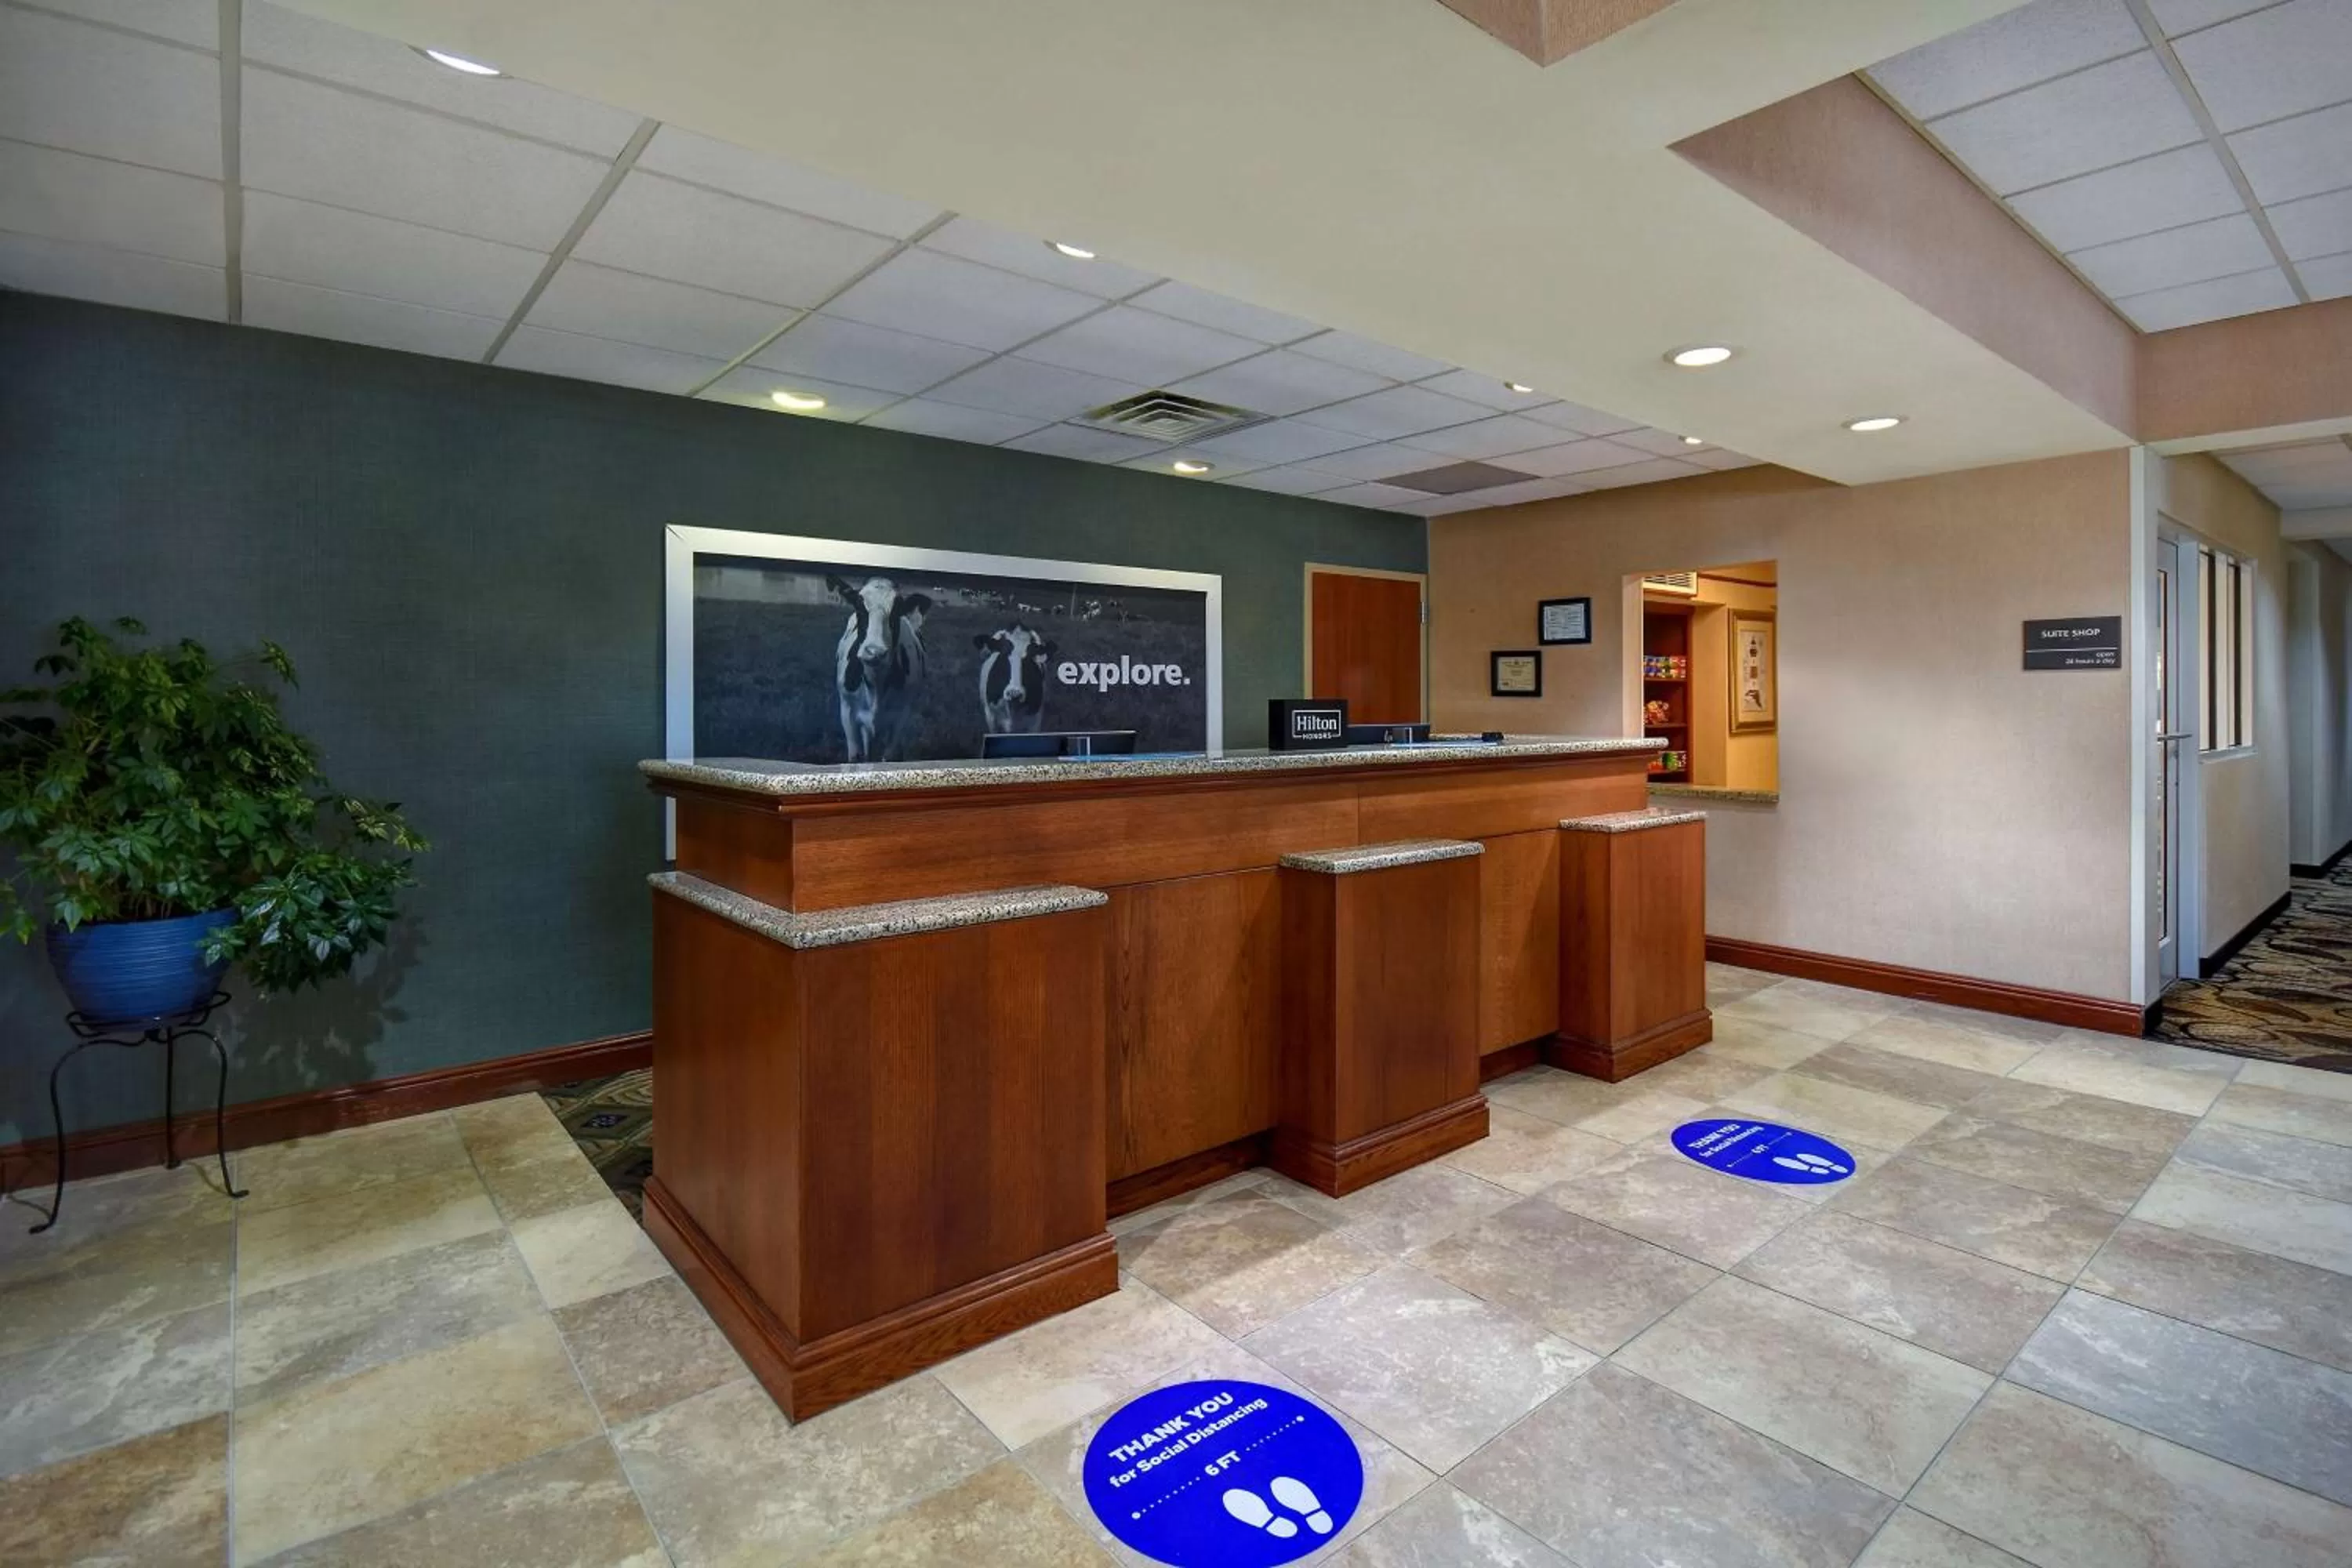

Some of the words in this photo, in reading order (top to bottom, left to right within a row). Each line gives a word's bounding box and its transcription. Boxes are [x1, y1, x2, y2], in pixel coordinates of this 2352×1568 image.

[2042, 630, 2069, 639] SUITE
[2072, 628, 2100, 637] SHOP
[1058, 655, 1191, 692] explore.
[1296, 714, 1337, 731] Hilton
[1109, 1416, 1191, 1462] THANK
[1186, 1392, 1233, 1420] YOU
[1109, 1468, 1138, 1487] for
[1137, 1439, 1189, 1473] Social
[1185, 1398, 1268, 1445] Distancing
[1204, 1463, 1220, 1477] 6
[1216, 1450, 1241, 1470] FT
